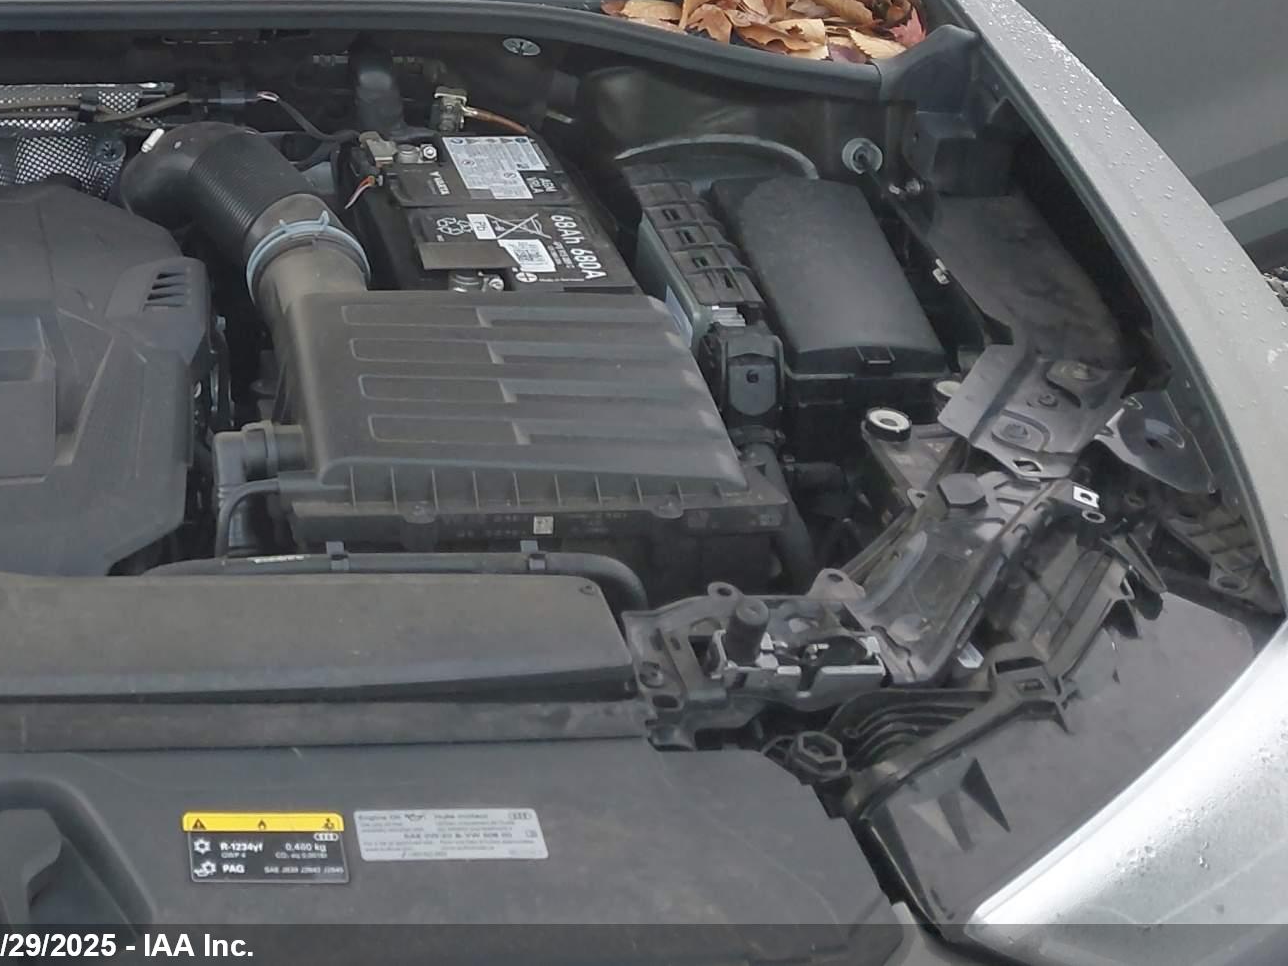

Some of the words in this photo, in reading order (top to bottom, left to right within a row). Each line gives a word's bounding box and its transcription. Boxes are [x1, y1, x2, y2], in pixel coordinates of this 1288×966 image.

[551, 215, 585, 244] 68Ah
[570, 248, 607, 279] 680A
[219, 842, 263, 853] R-1234yf
[314, 842, 327, 852] kg
[222, 864, 245, 874] PAG
